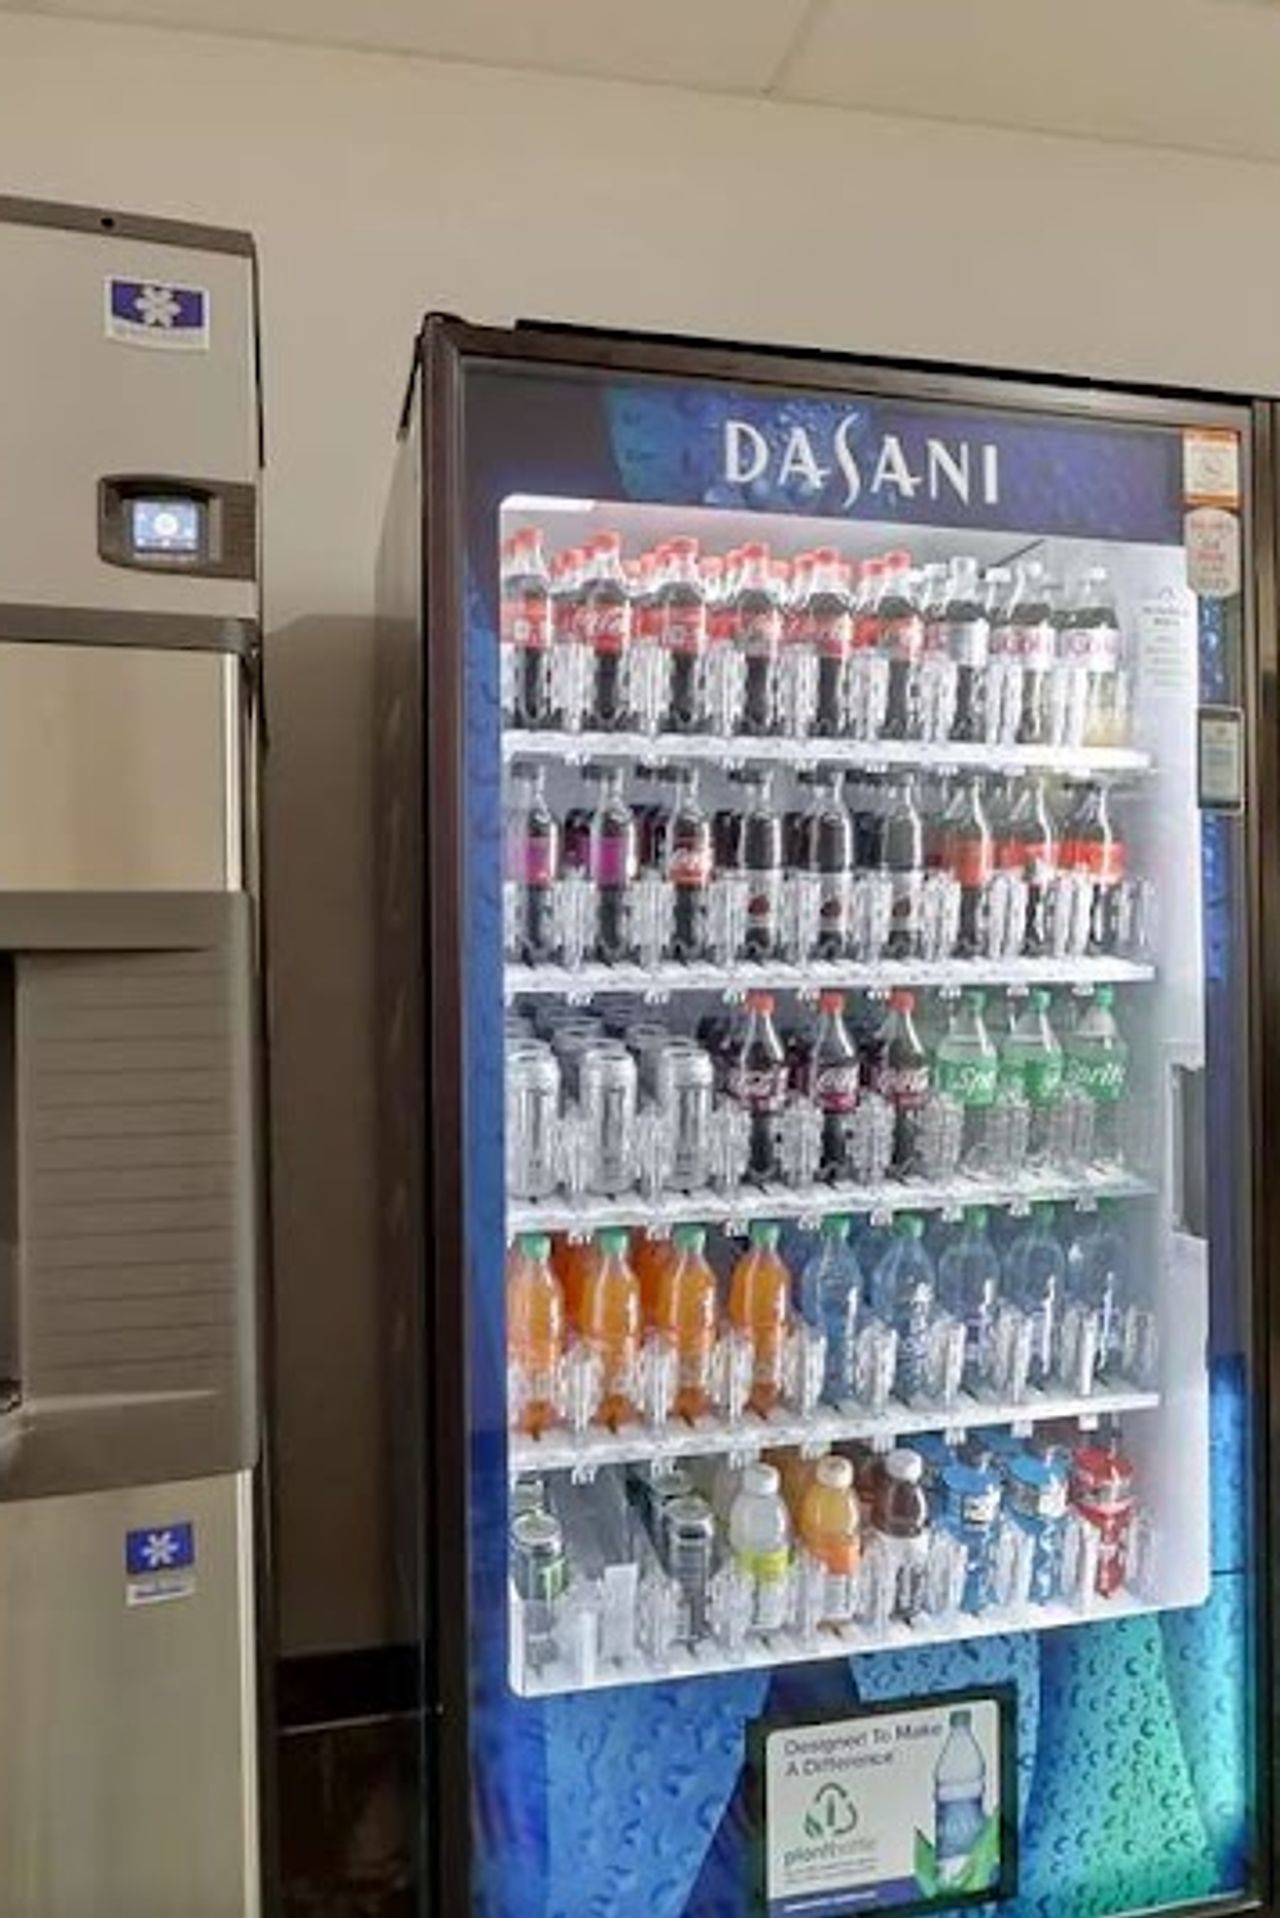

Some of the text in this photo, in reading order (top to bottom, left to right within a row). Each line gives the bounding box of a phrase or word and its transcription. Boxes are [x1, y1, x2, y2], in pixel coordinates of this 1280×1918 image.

[725, 412, 999, 509] DASANI
[785, 1723, 943, 1755] Designed To Make
[784, 1752, 893, 1776] A Difference
